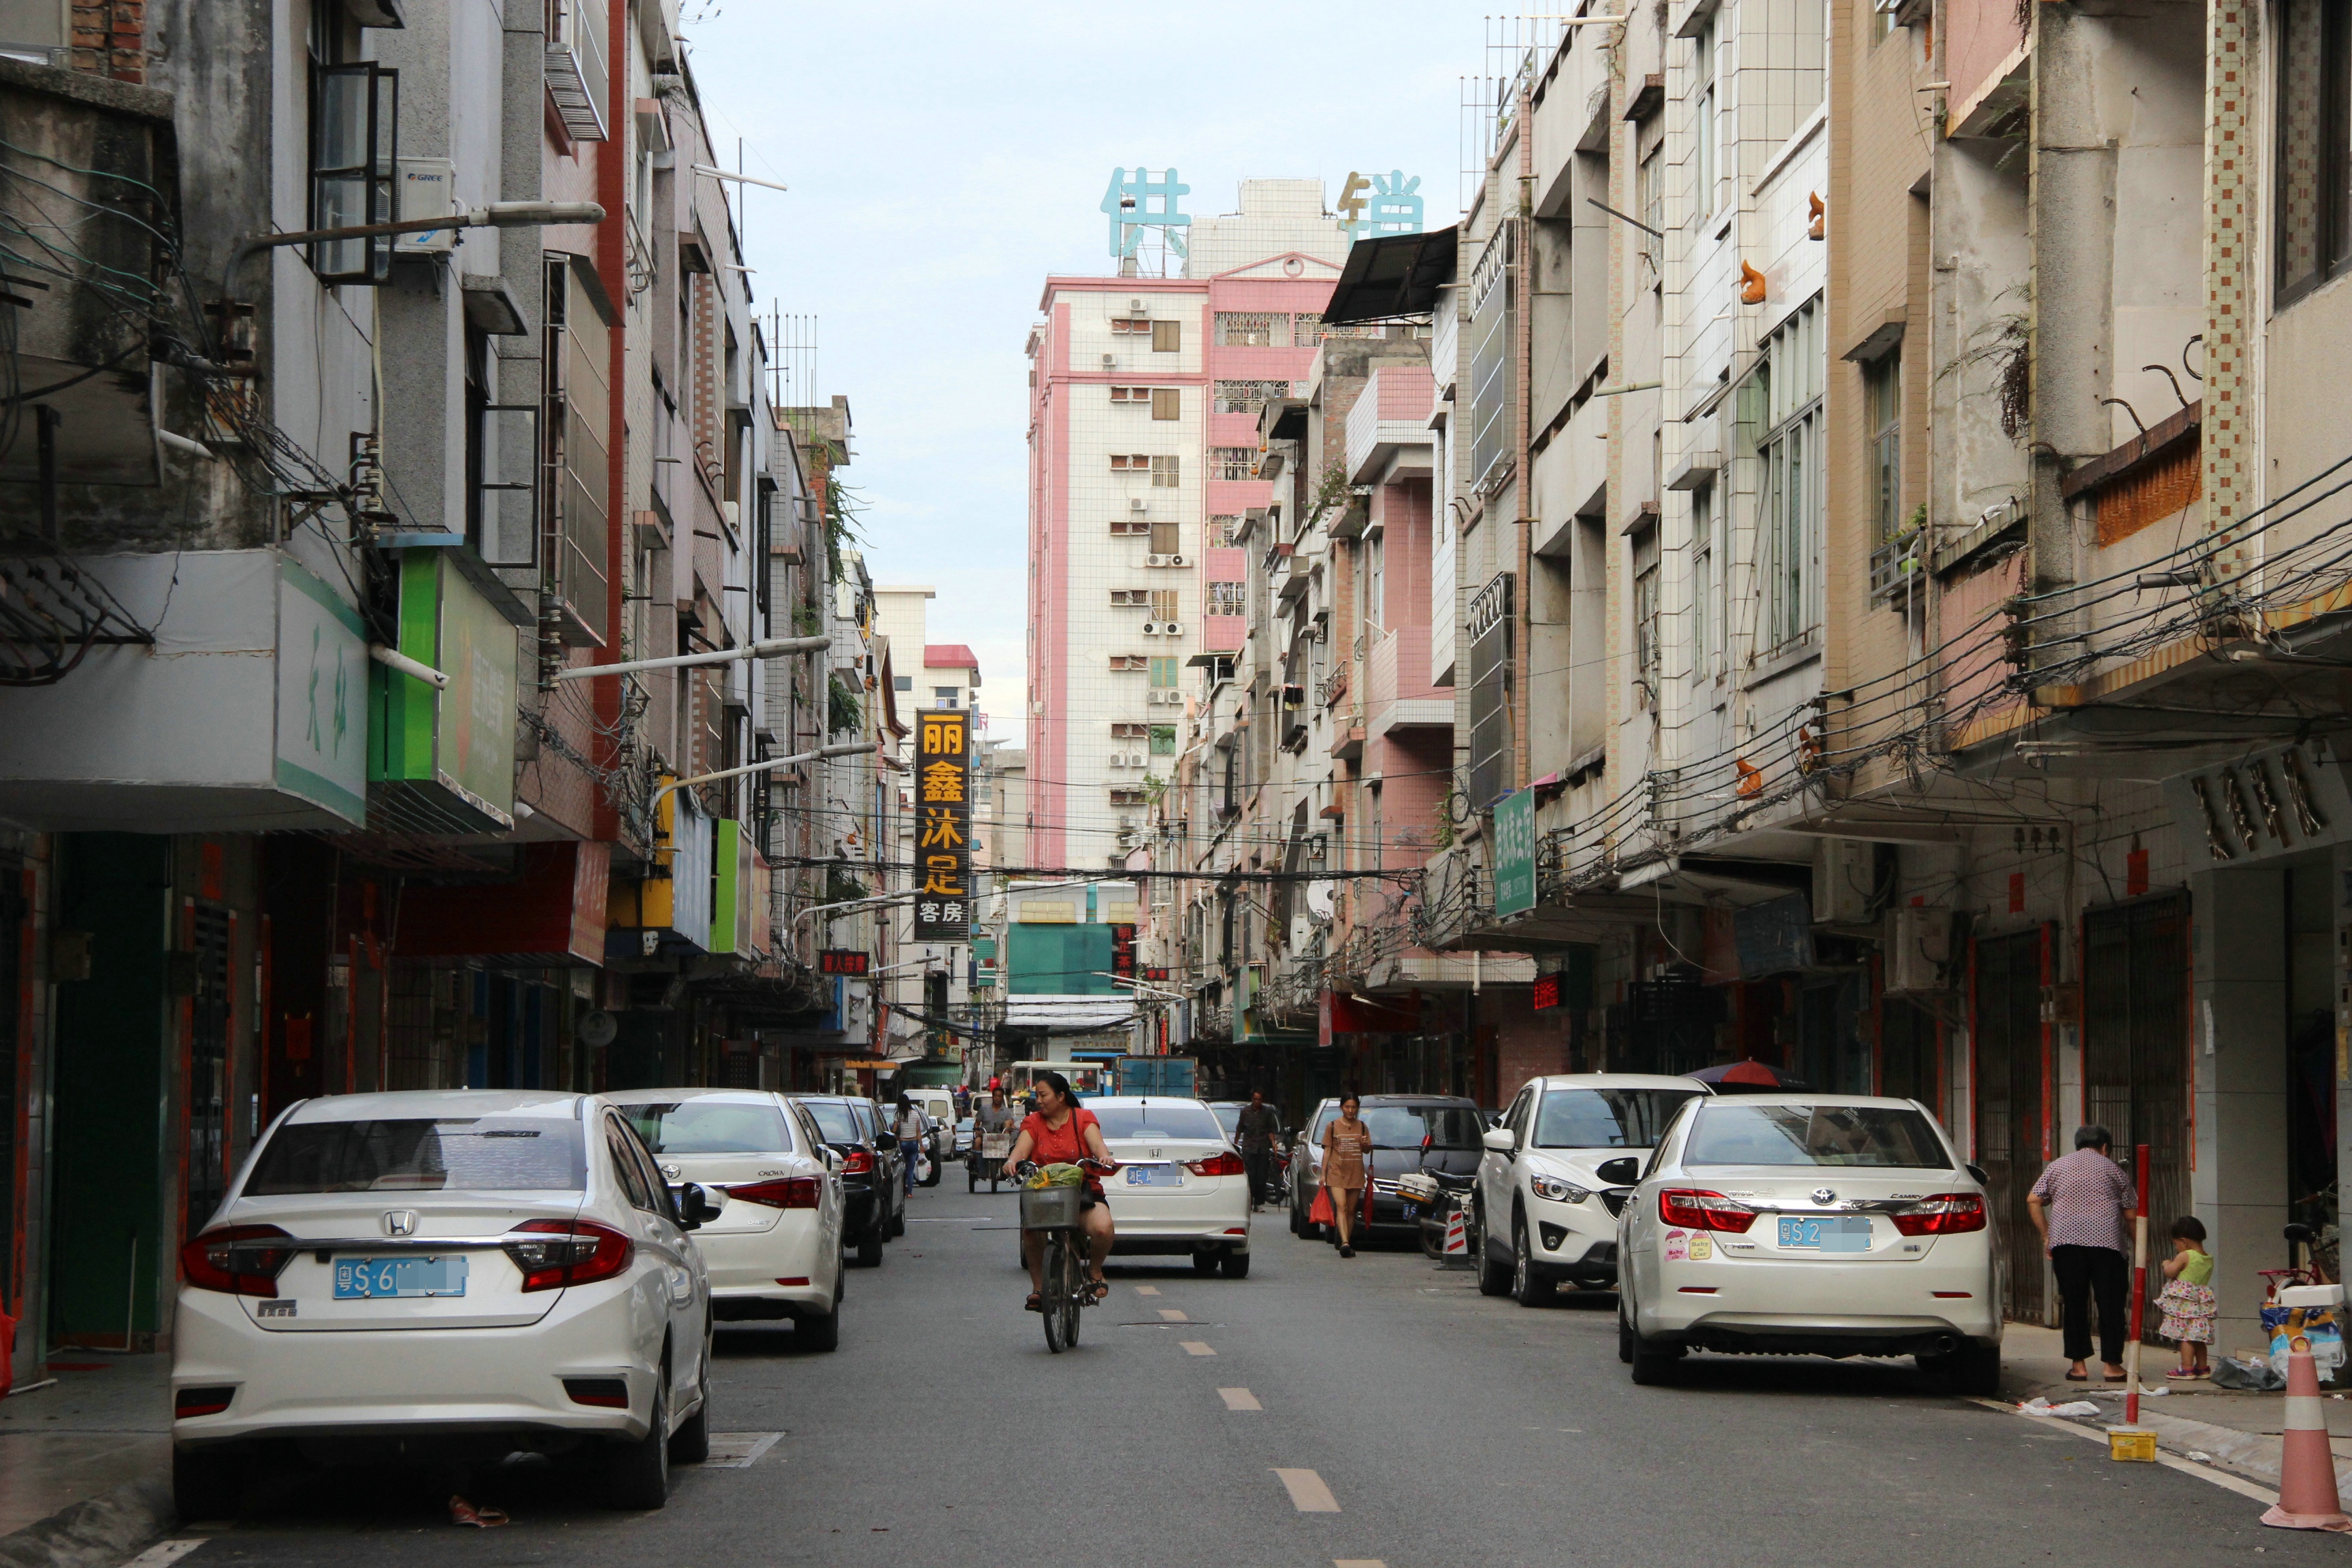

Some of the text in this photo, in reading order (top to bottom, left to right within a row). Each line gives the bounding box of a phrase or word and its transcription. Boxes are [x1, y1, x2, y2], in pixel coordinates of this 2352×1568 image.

[921, 715, 964, 895] 丽鑫沐足
[919, 900, 963, 923] 客房
[823, 954, 865, 973] 盲人按摩
